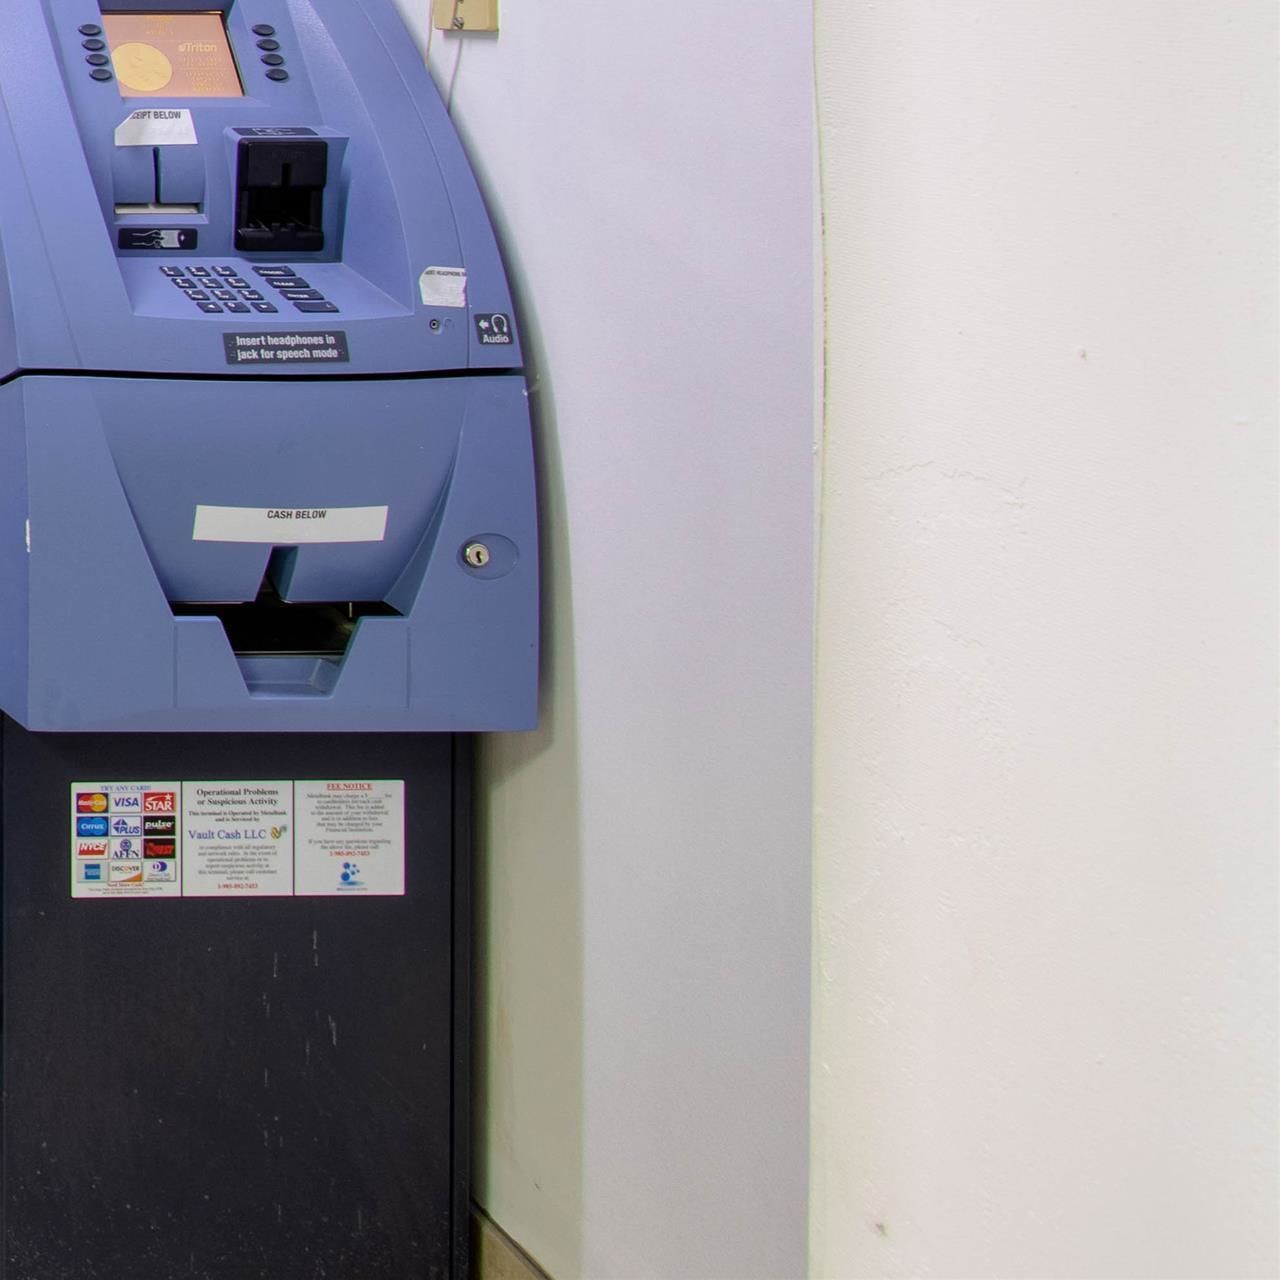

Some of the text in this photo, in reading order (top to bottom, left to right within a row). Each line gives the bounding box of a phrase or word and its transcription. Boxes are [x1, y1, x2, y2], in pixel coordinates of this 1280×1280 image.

[186, 42, 217, 52] Triton
[154, 111, 181, 119] BELOW
[236, 334, 335, 347] Insert headphones in
[483, 334, 509, 343] Audio
[237, 347, 338, 361] jack for speech mode
[267, 510, 326, 519] CASH BELOW
[197, 788, 241, 797] Operational
[113, 798, 139, 807] VISA
[146, 802, 172, 810] STAR
[249, 798, 278, 806] Activity
[145, 820, 172, 829] pulse
[120, 826, 140, 834] PLUS
[188, 829, 266, 839] Vault Cash LLC
[80, 842, 105, 850] NYCE
[113, 850, 139, 858] AFFN
